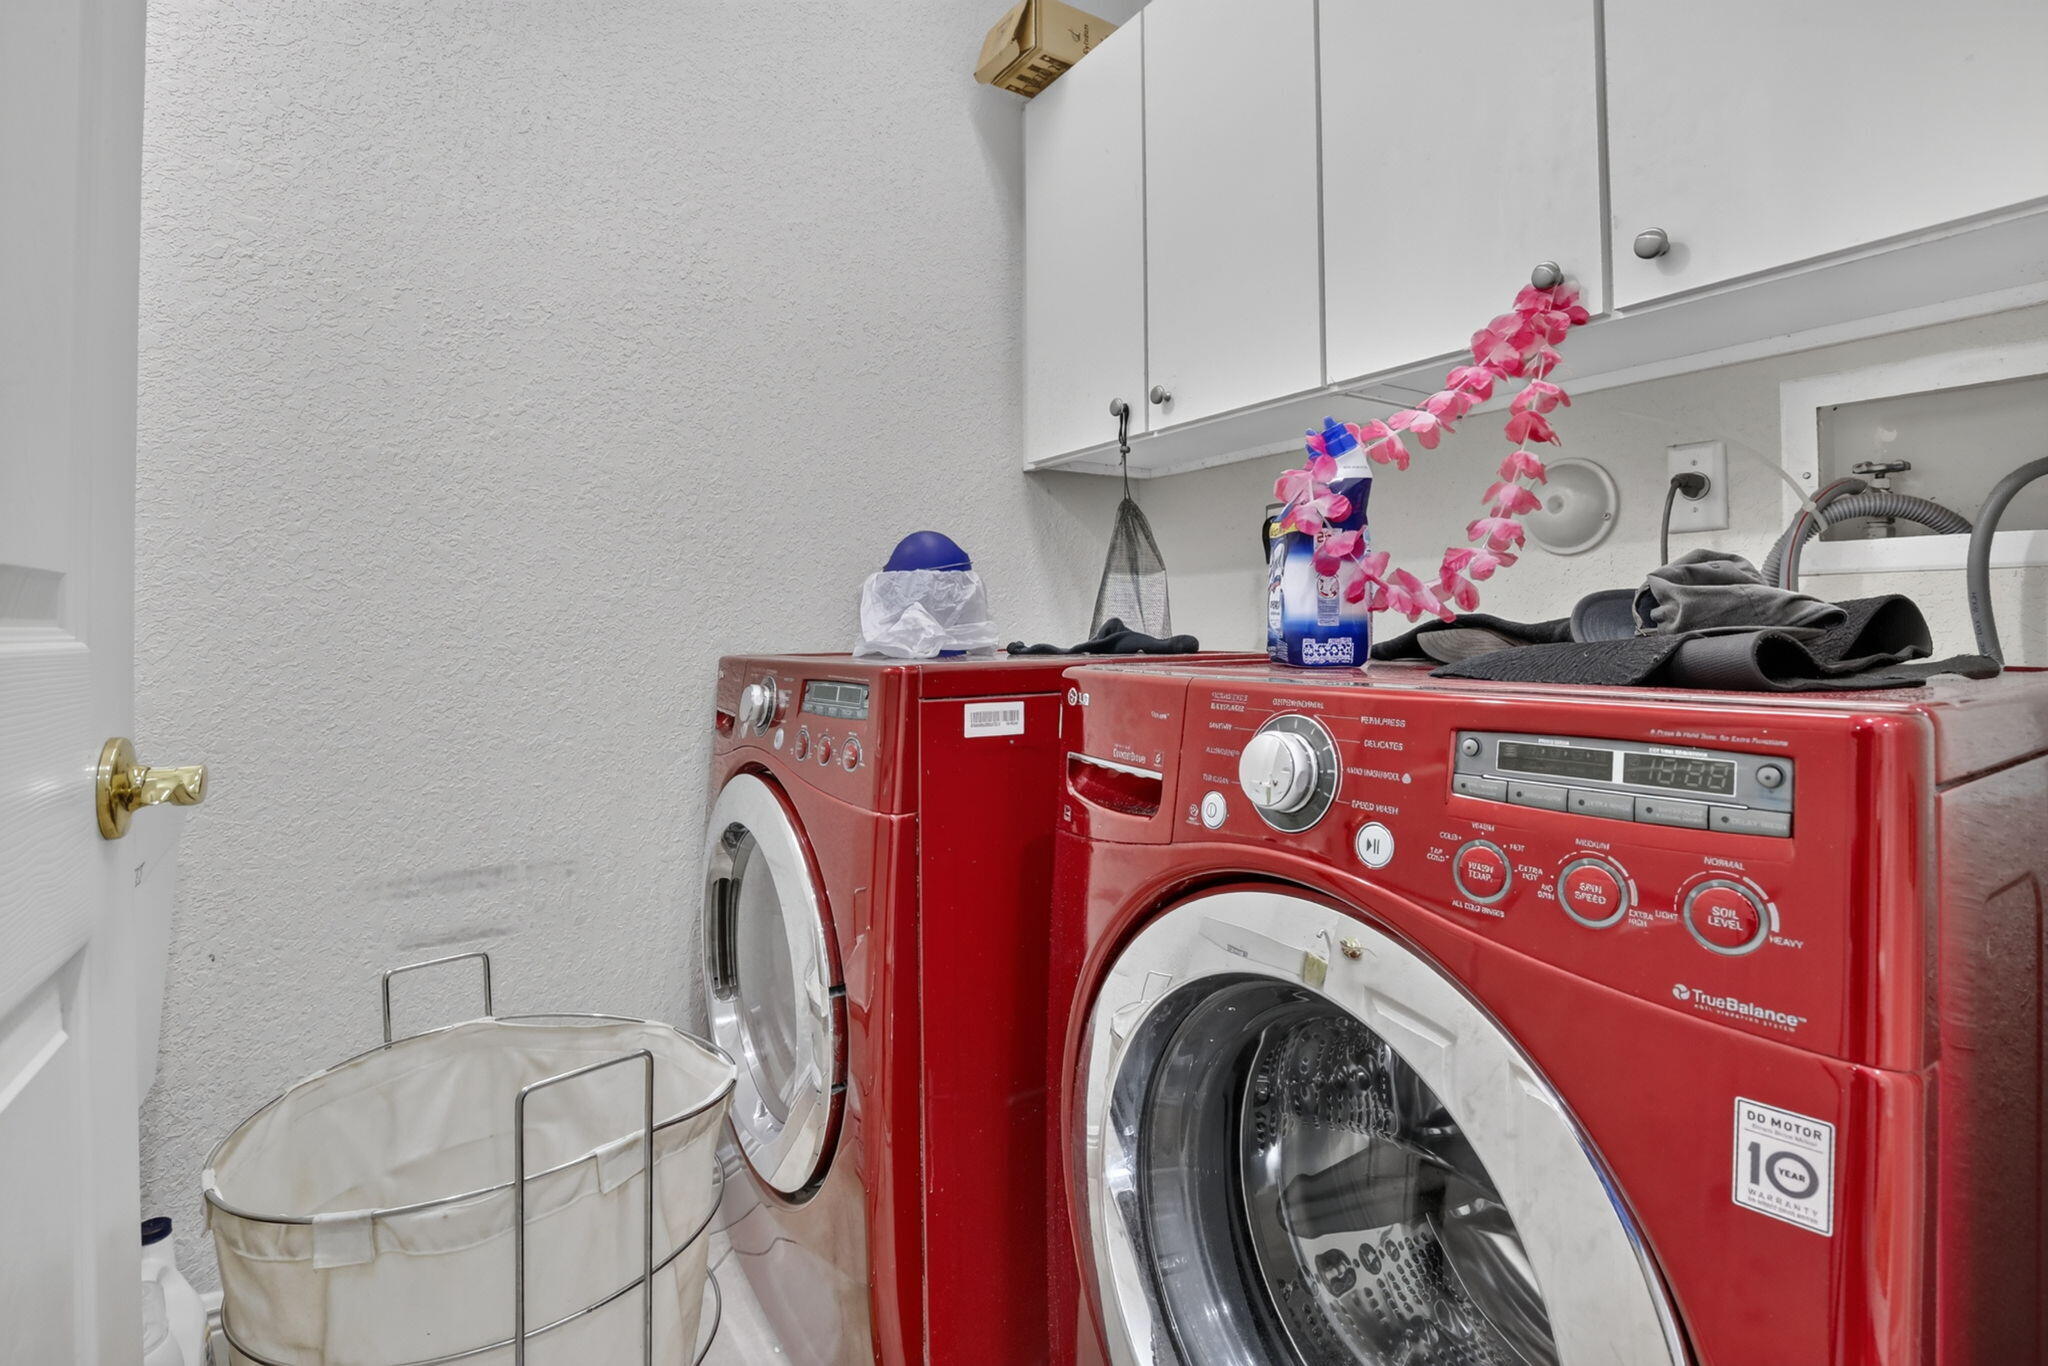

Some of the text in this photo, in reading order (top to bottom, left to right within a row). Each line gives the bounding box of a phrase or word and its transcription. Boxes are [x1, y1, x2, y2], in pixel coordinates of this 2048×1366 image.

[1364, 739, 1404, 751] DELICATES
[1704, 856, 1745, 871] NORMAL
[1579, 882, 1602, 894] SPIN
[1574, 890, 1607, 905] SPEED
[1711, 906, 1739, 920] SOIL
[1707, 916, 1743, 931] LEVEL
[1769, 935, 1804, 949] HEAVY
[1747, 1110, 1766, 1124] DD
[1770, 1117, 1823, 1142] MOTOR
[1747, 1141, 1820, 1200] 10
[1778, 1166, 1806, 1183] YEAR
[1748, 1187, 1819, 1218] WARRANTY
